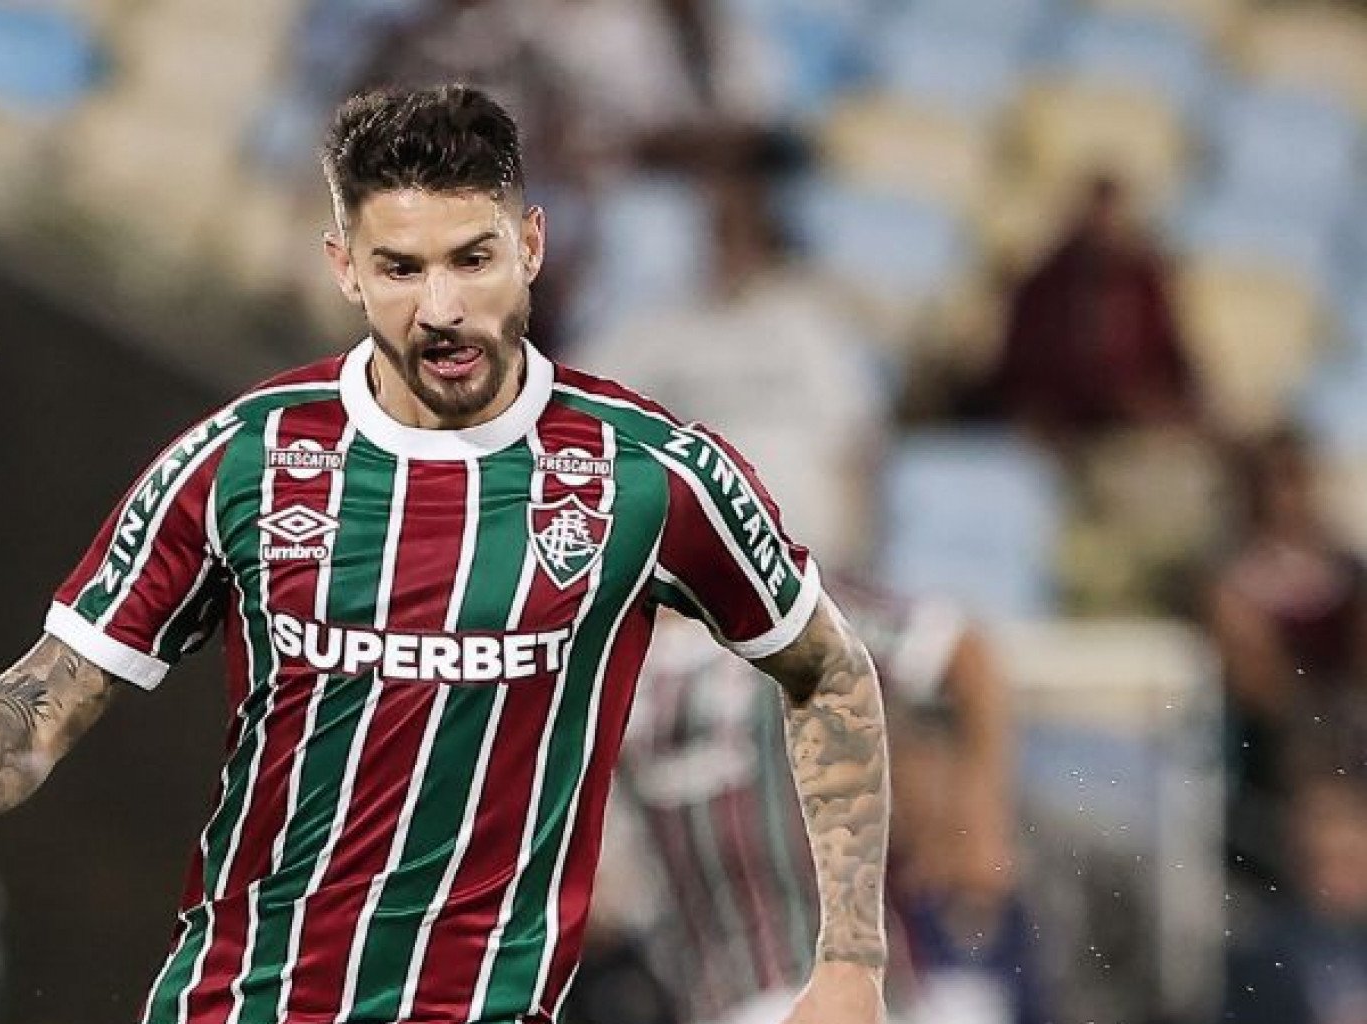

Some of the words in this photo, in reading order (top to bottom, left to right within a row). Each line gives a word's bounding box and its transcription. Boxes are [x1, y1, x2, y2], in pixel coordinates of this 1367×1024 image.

[663, 429, 787, 597] ZINZANE
[264, 542, 328, 560] umbro
[272, 612, 572, 681] SUPERBET
